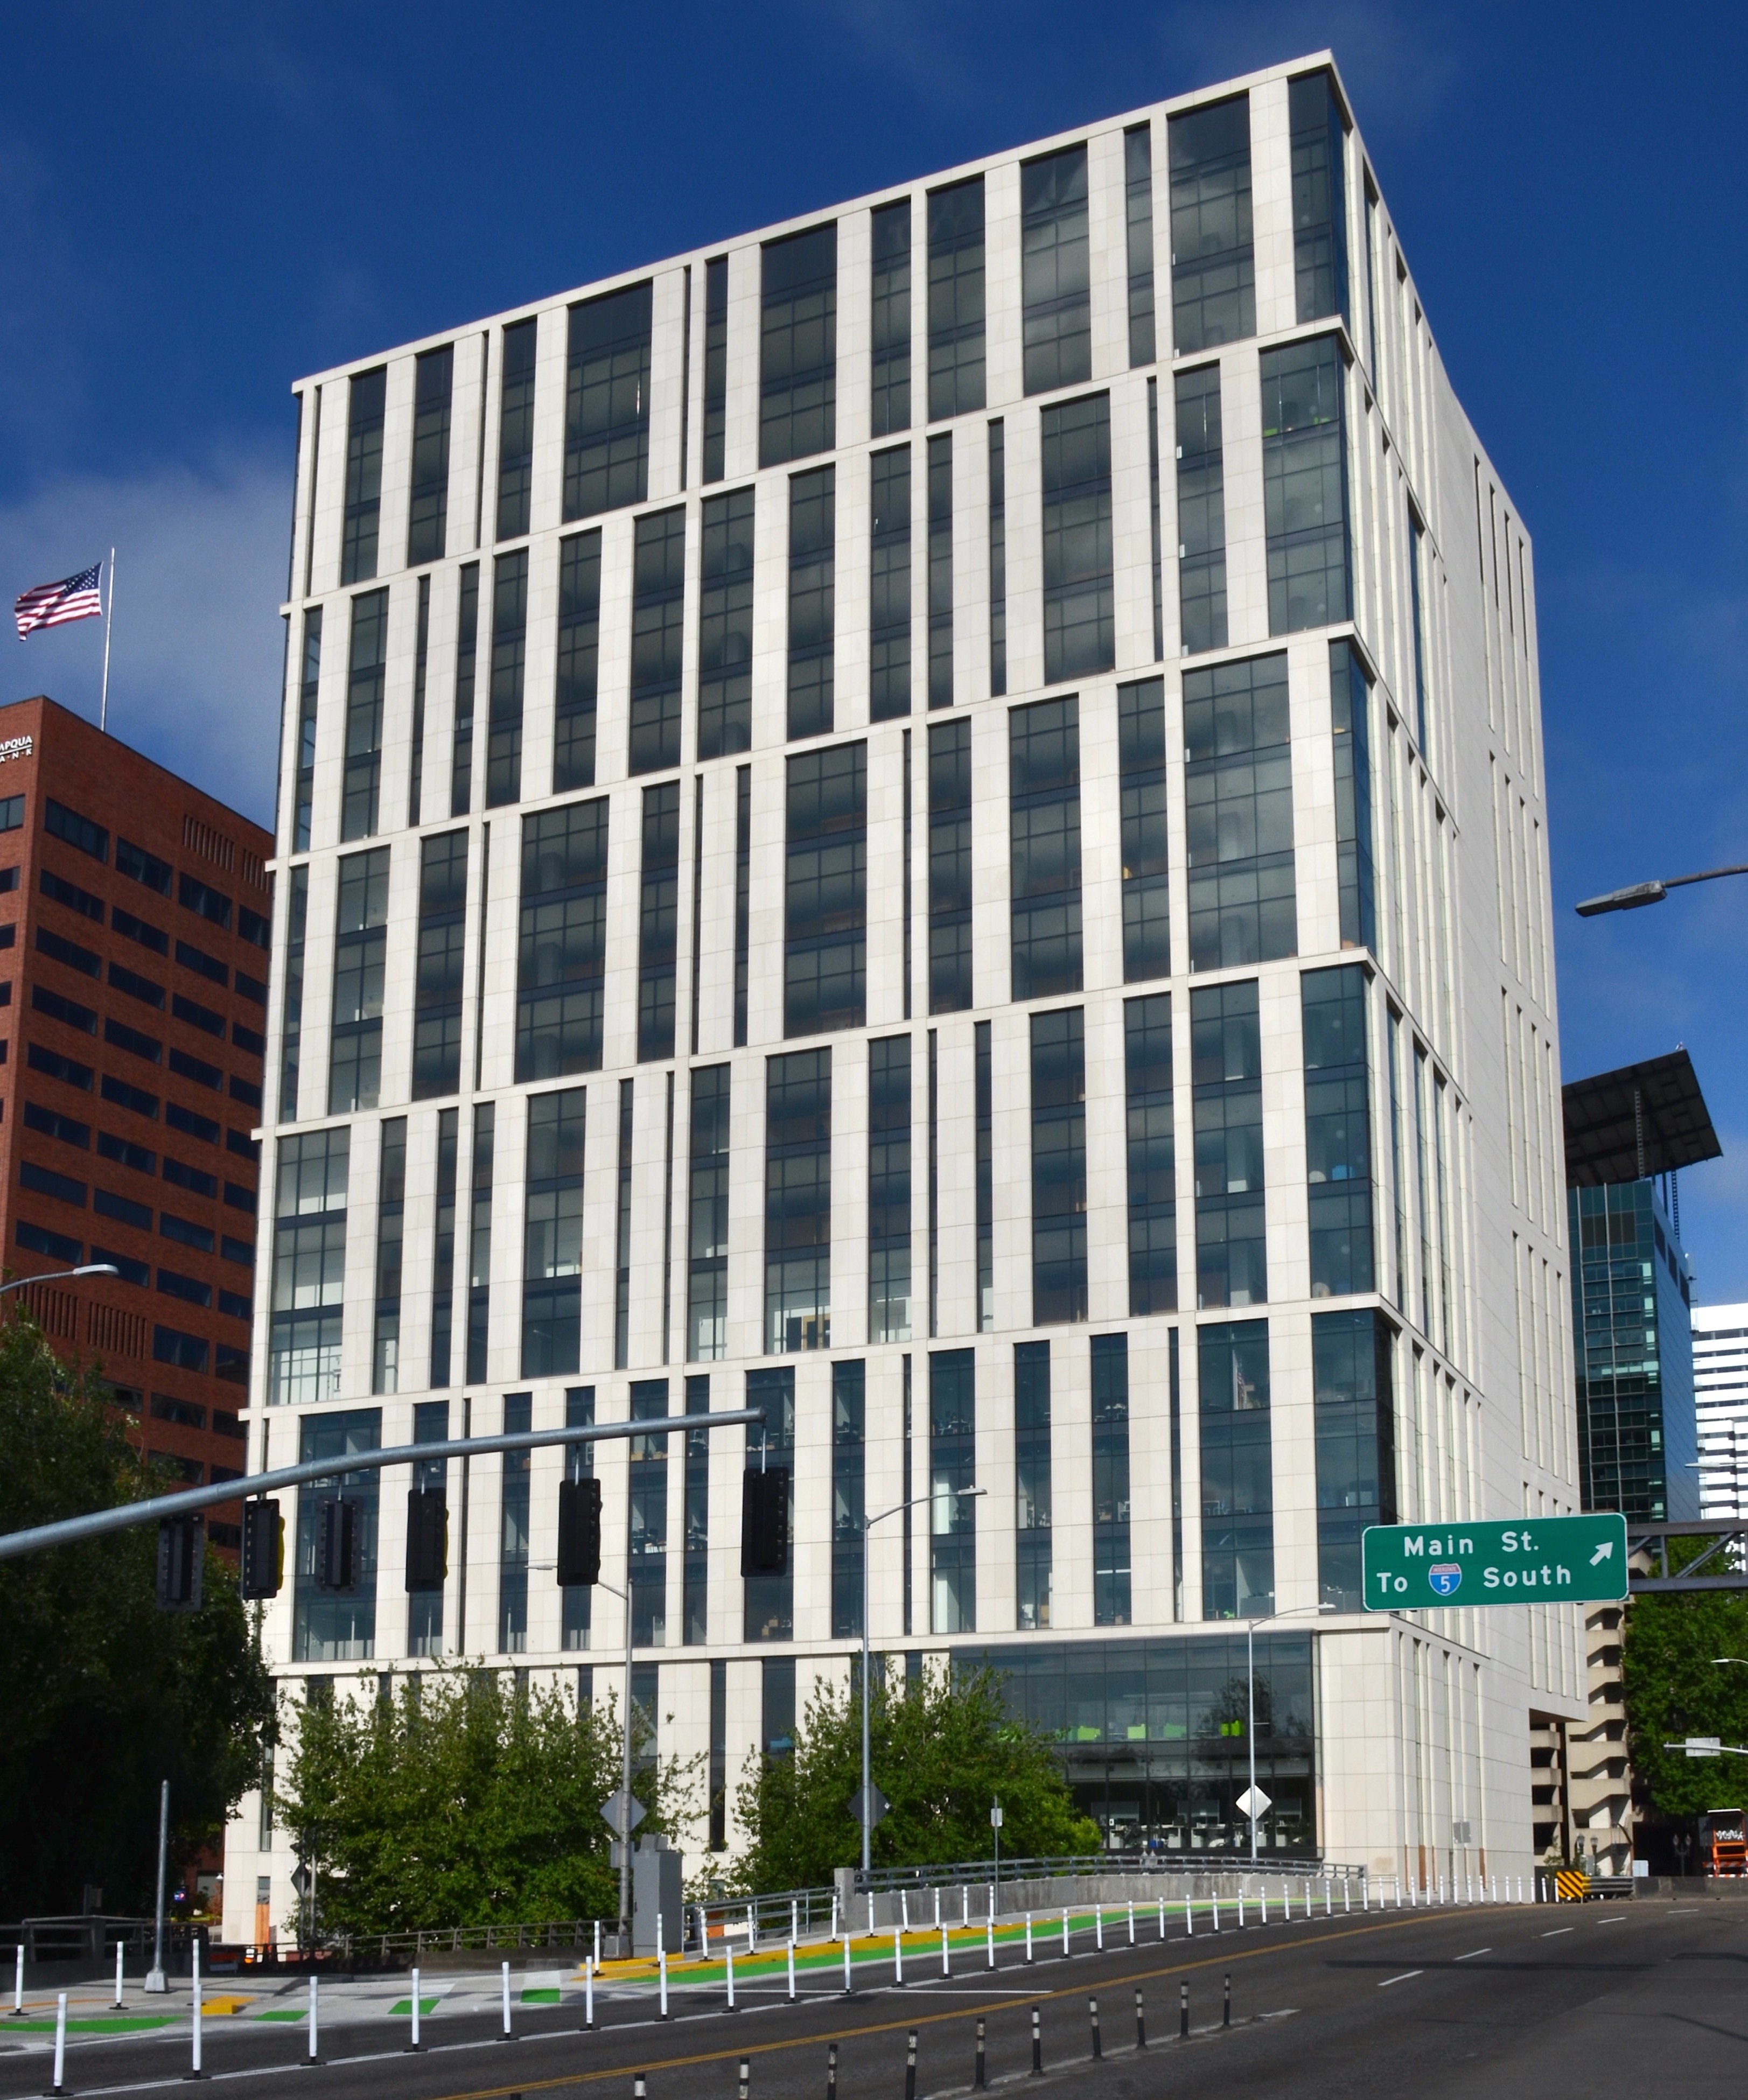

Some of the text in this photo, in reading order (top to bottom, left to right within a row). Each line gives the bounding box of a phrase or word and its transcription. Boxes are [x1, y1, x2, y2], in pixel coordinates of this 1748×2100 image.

[1404, 1531, 1539, 1557] Main St.
[1376, 1564, 1571, 1593] To 5 South
